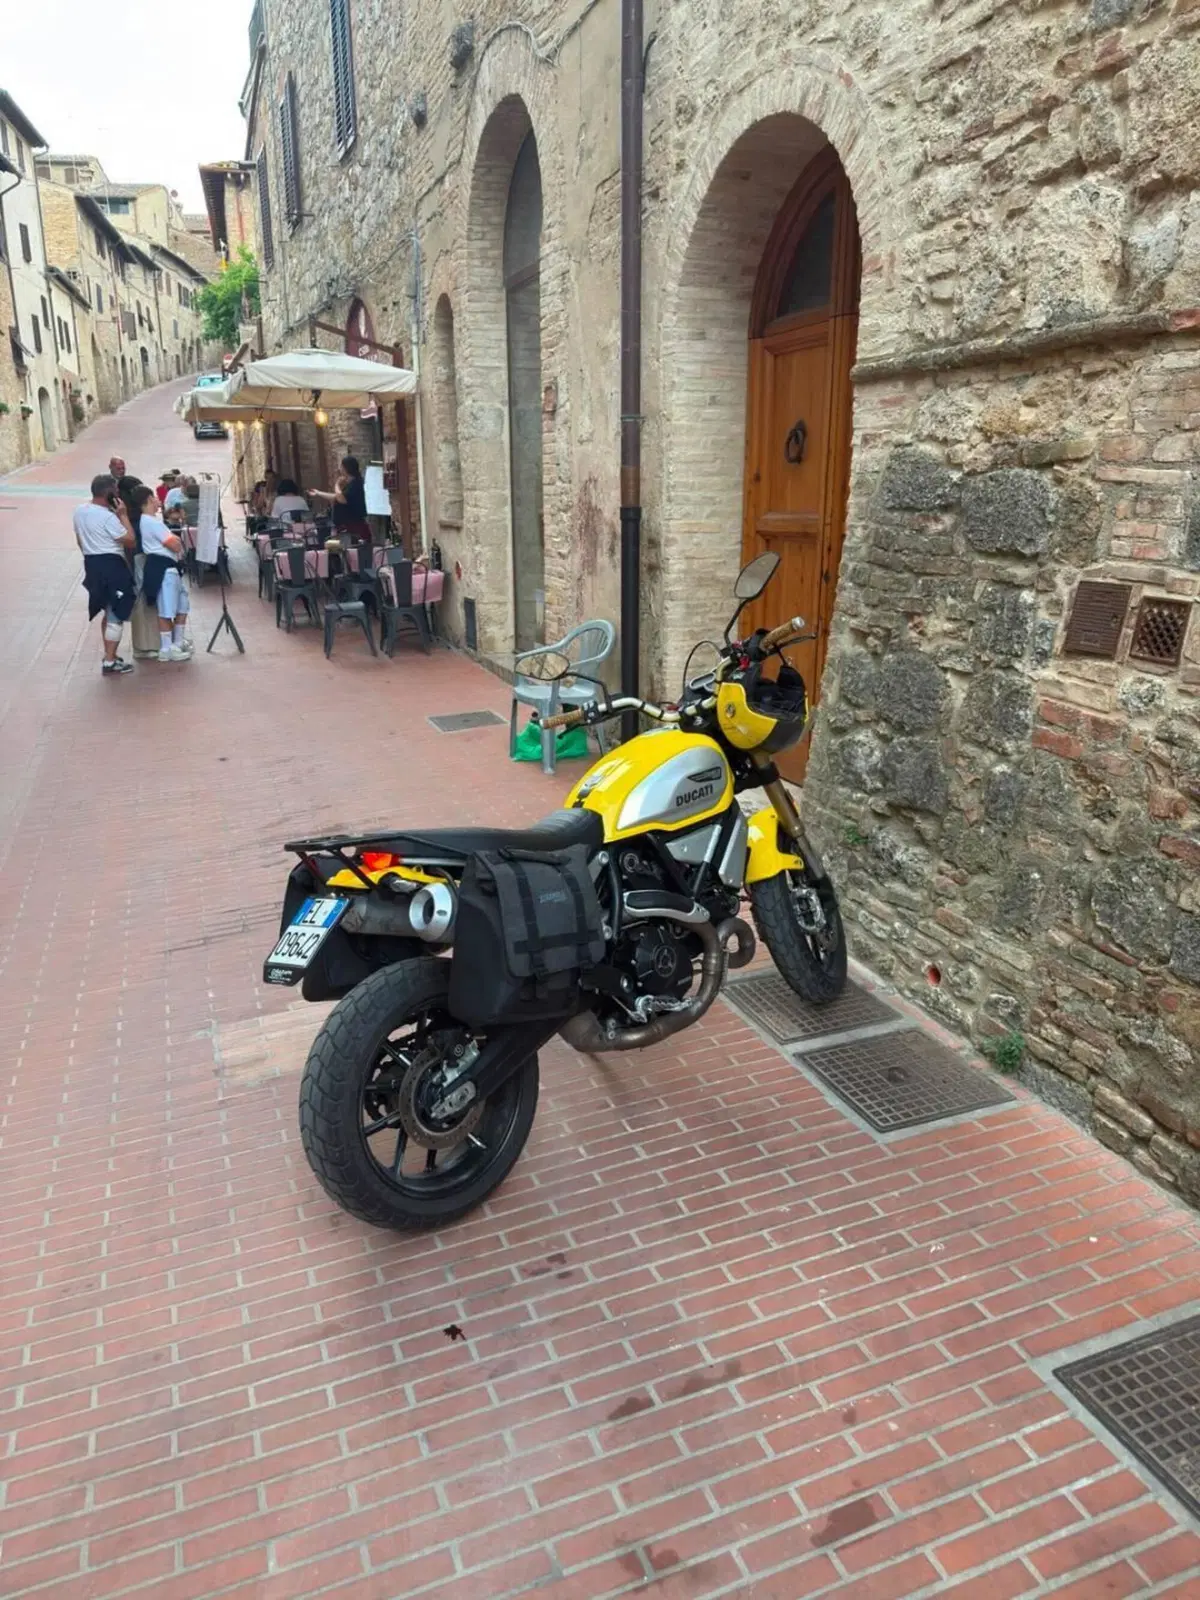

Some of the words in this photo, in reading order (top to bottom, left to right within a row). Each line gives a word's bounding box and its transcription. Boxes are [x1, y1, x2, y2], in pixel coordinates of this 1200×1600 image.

[676, 784, 713, 807] DUCATI
[302, 900, 324, 924] EL
[274, 931, 321, 960] 09642
